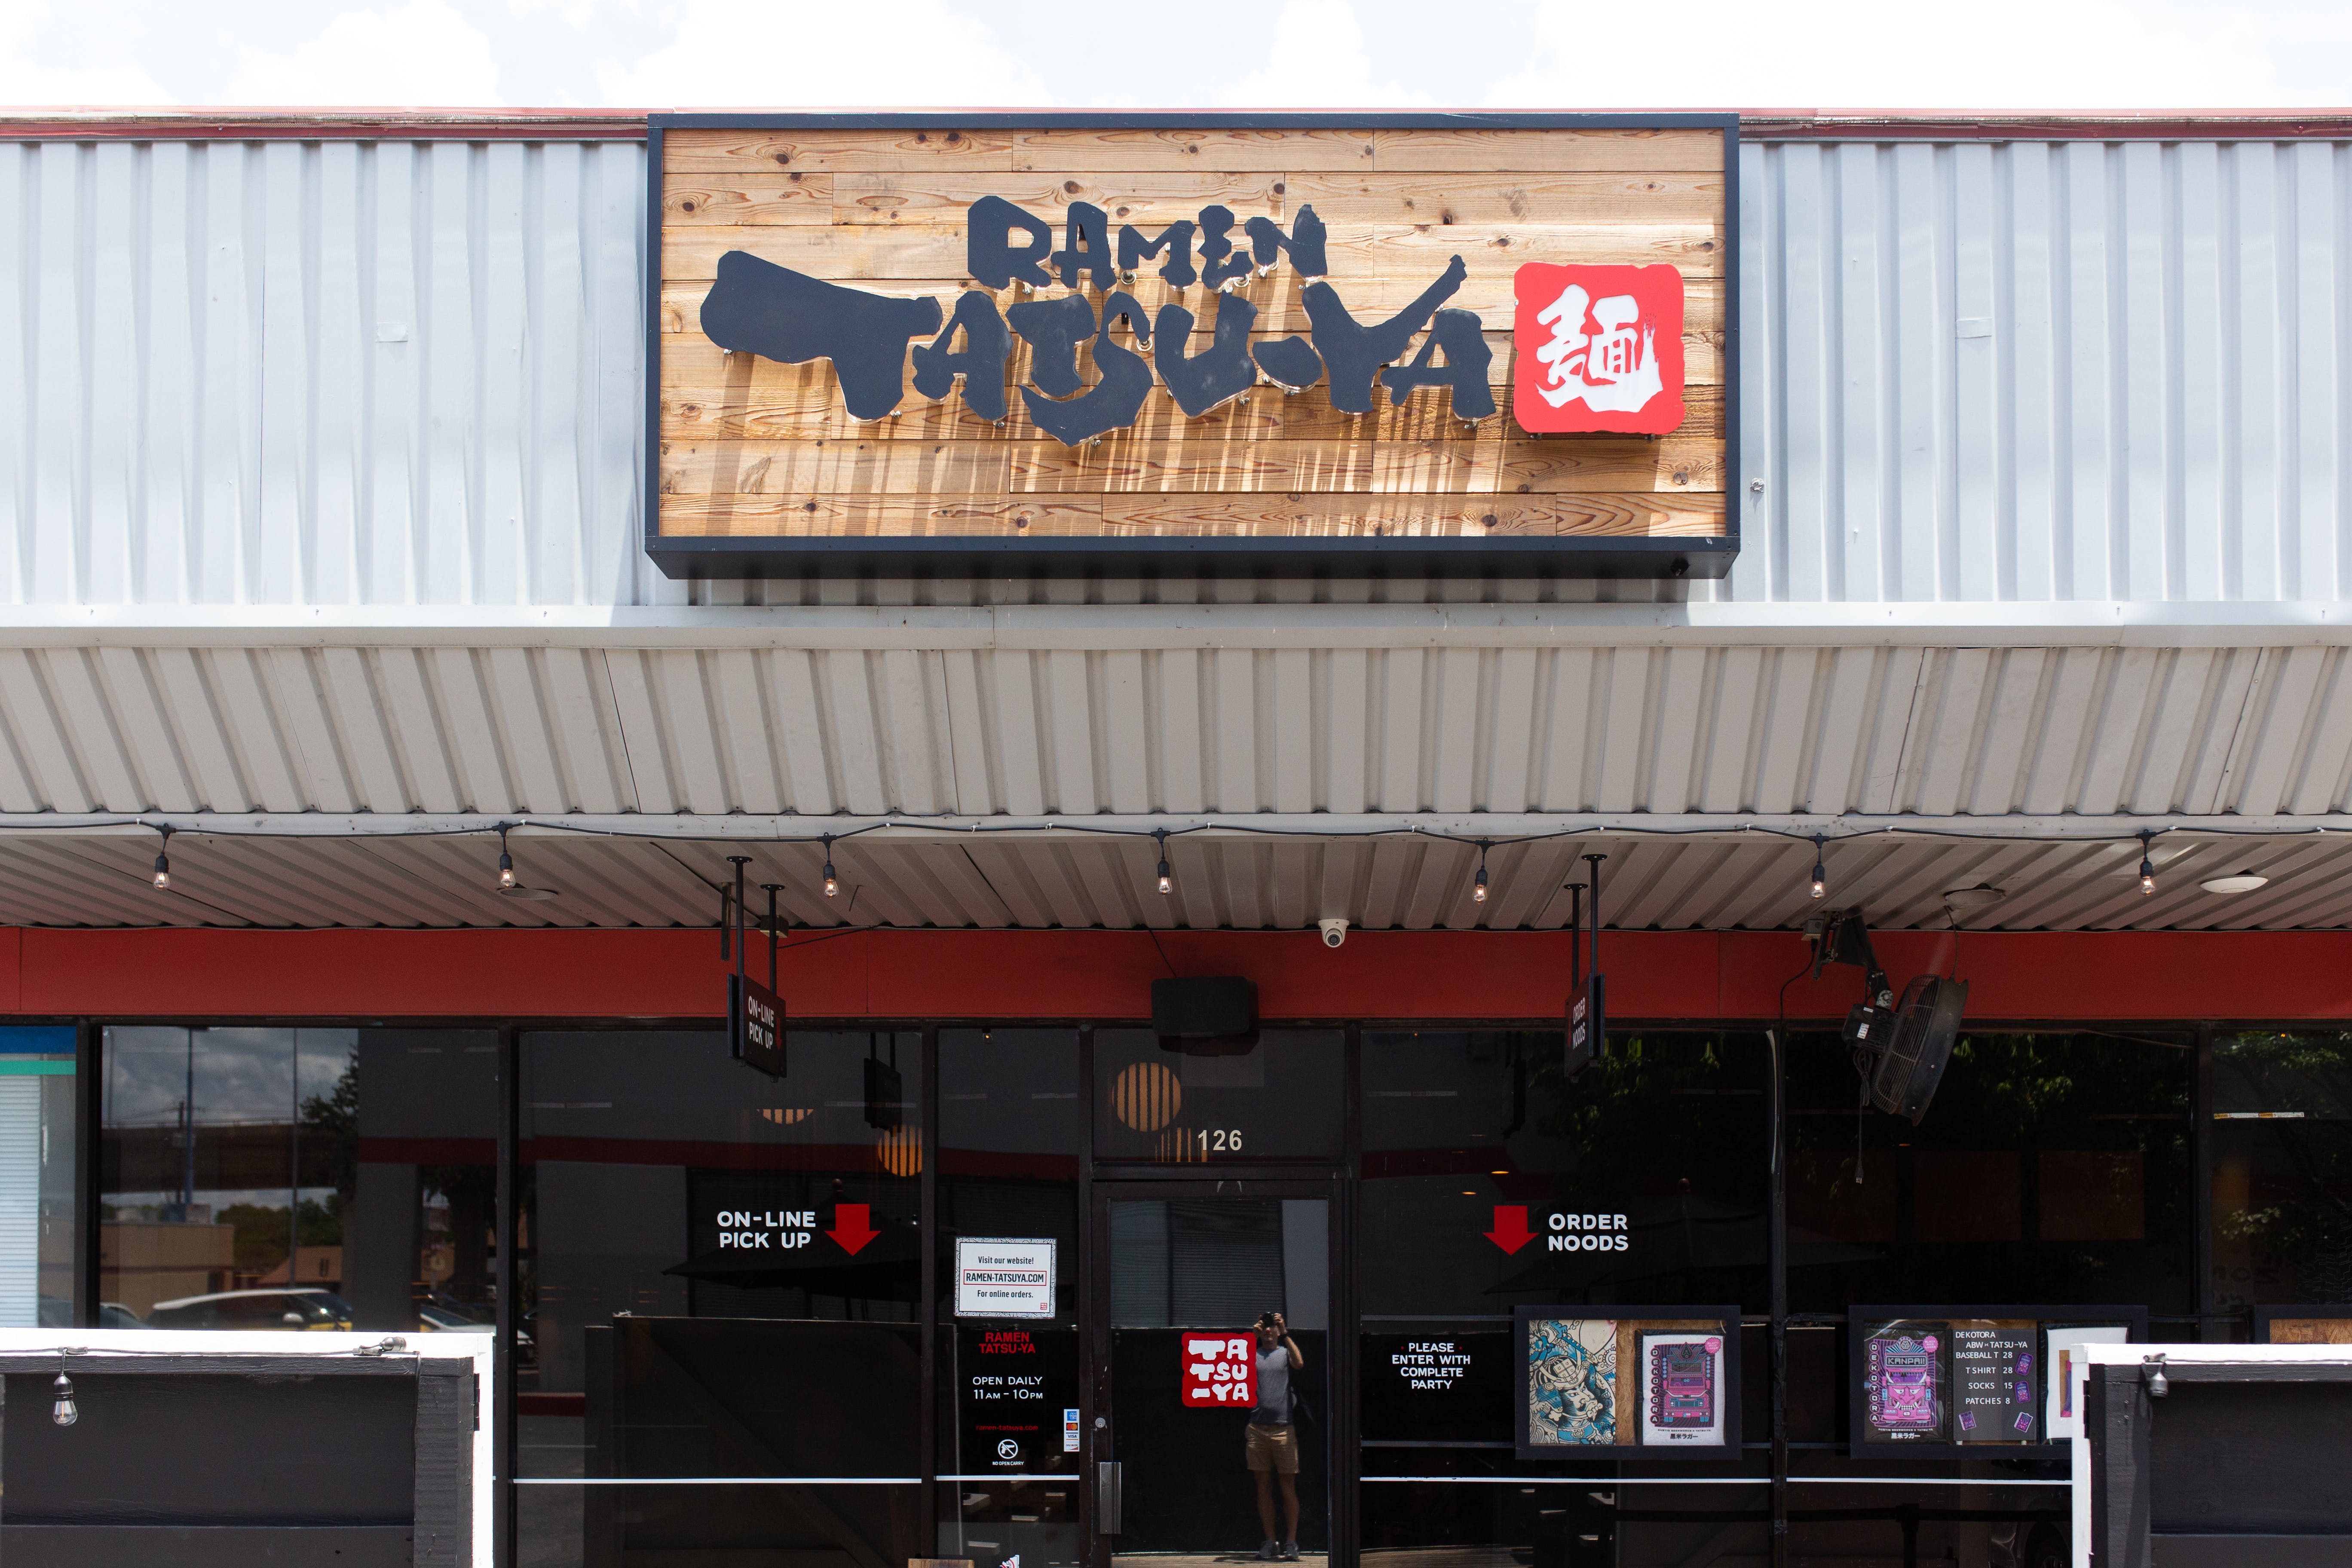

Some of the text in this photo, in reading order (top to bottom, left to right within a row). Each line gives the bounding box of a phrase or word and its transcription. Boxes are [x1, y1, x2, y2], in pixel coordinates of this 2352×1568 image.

[967, 195, 1328, 290] RAMEN
[699, 250, 1497, 447] TATSU-YA
[748, 995, 774, 1028] ON-LINE
[1573, 997, 1585, 1025] ORDER
[749, 1021, 773, 1049] PICK UP
[1572, 1022, 1585, 1050] NOODS
[1197, 1129, 1242, 1151] 126
[717, 1211, 816, 1227] ON-LINE
[1549, 1213, 1628, 1230] ORDER
[720, 1232, 811, 1248] PICK UP
[1548, 1235, 1629, 1251] NOODS
[978, 1256, 993, 1264] Visit
[966, 1273, 1044, 1283] RAMEN-TATSUYA.COM
[985, 1332, 1029, 1342] RAMEN
[978, 1343, 1036, 1354] TATSU-YA
[1188, 1339, 1248, 1361] TA
[1409, 1342, 1455, 1353] PLEASE
[1392, 1354, 1470, 1365] ENTER WITH
[1189, 1362, 1248, 1381] TSU
[1400, 1367, 1464, 1377] COMPLETE
[972, 1376, 1043, 1385] OPEN DAILY
[1411, 1380, 1452, 1389] PARTY
[973, 1389, 1000, 1400] 11AM
[1013, 1389, 1043, 1400] 10PM
